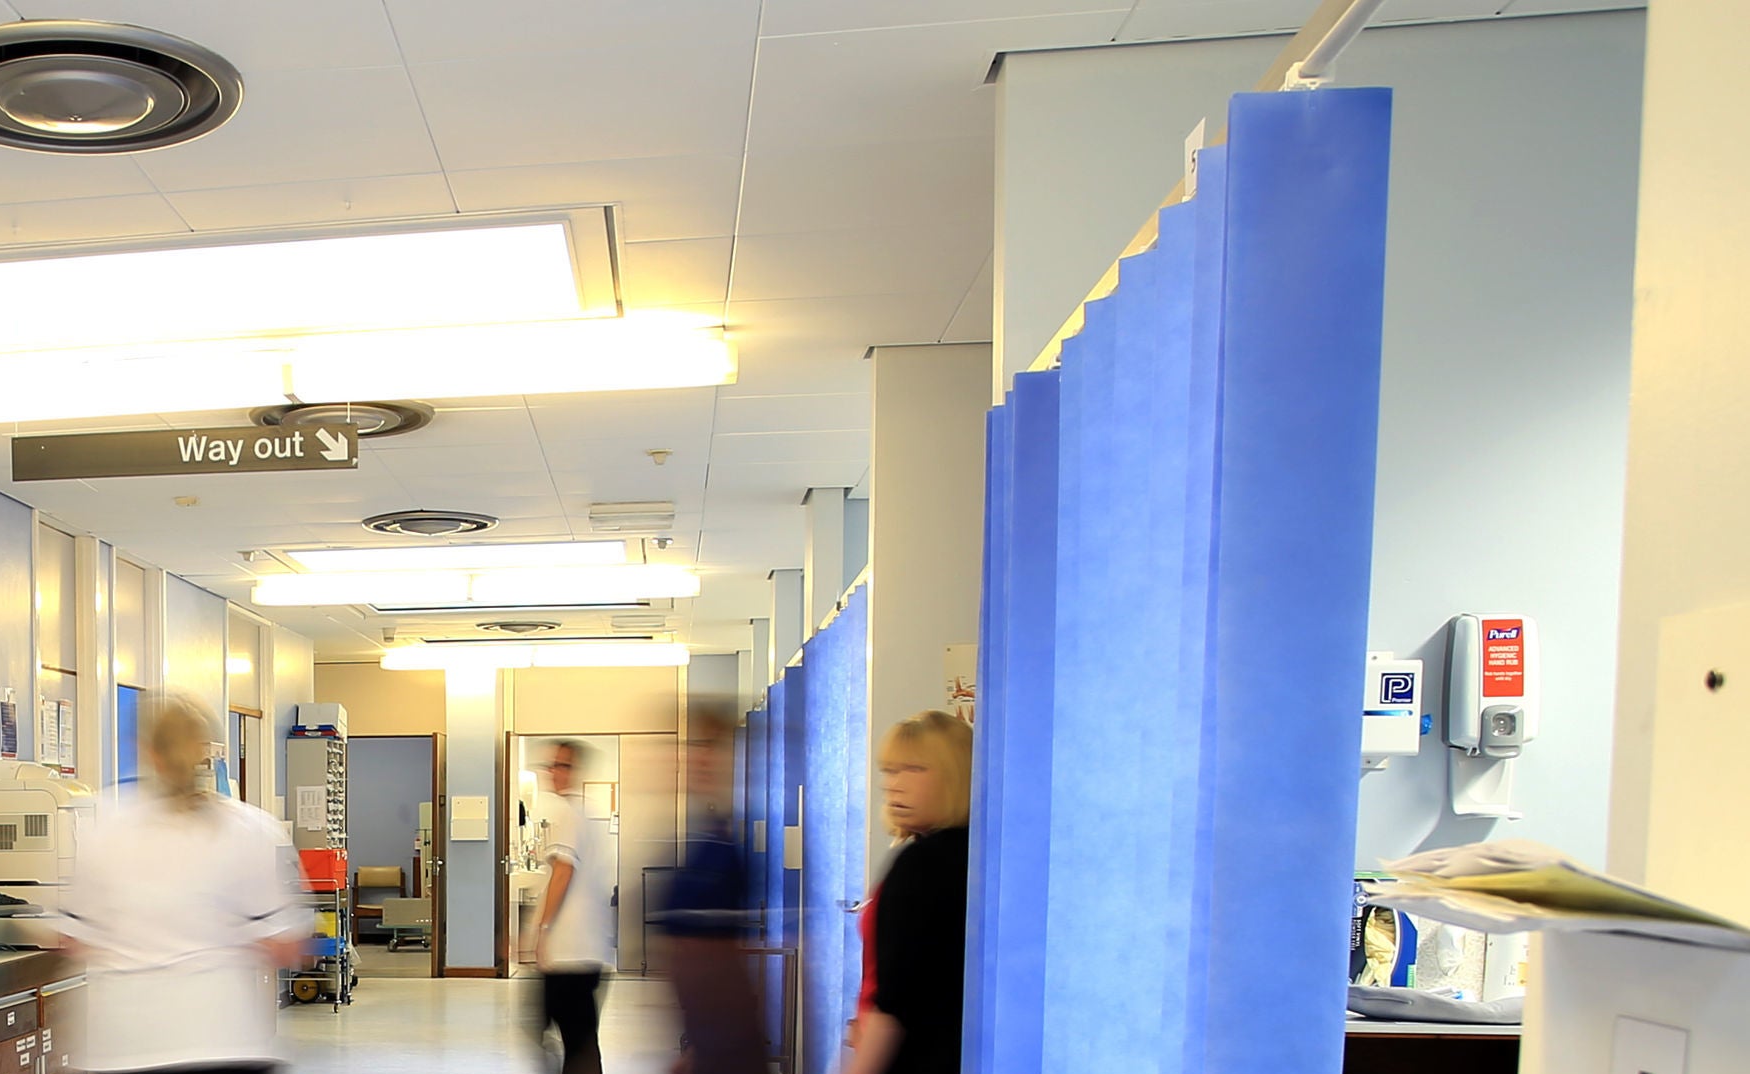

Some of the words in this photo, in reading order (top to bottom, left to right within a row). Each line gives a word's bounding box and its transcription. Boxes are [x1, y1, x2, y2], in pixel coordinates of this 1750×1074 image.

[177, 435, 245, 466] Way
[253, 430, 305, 459] out
[1488, 628, 1518, 639] Purell
